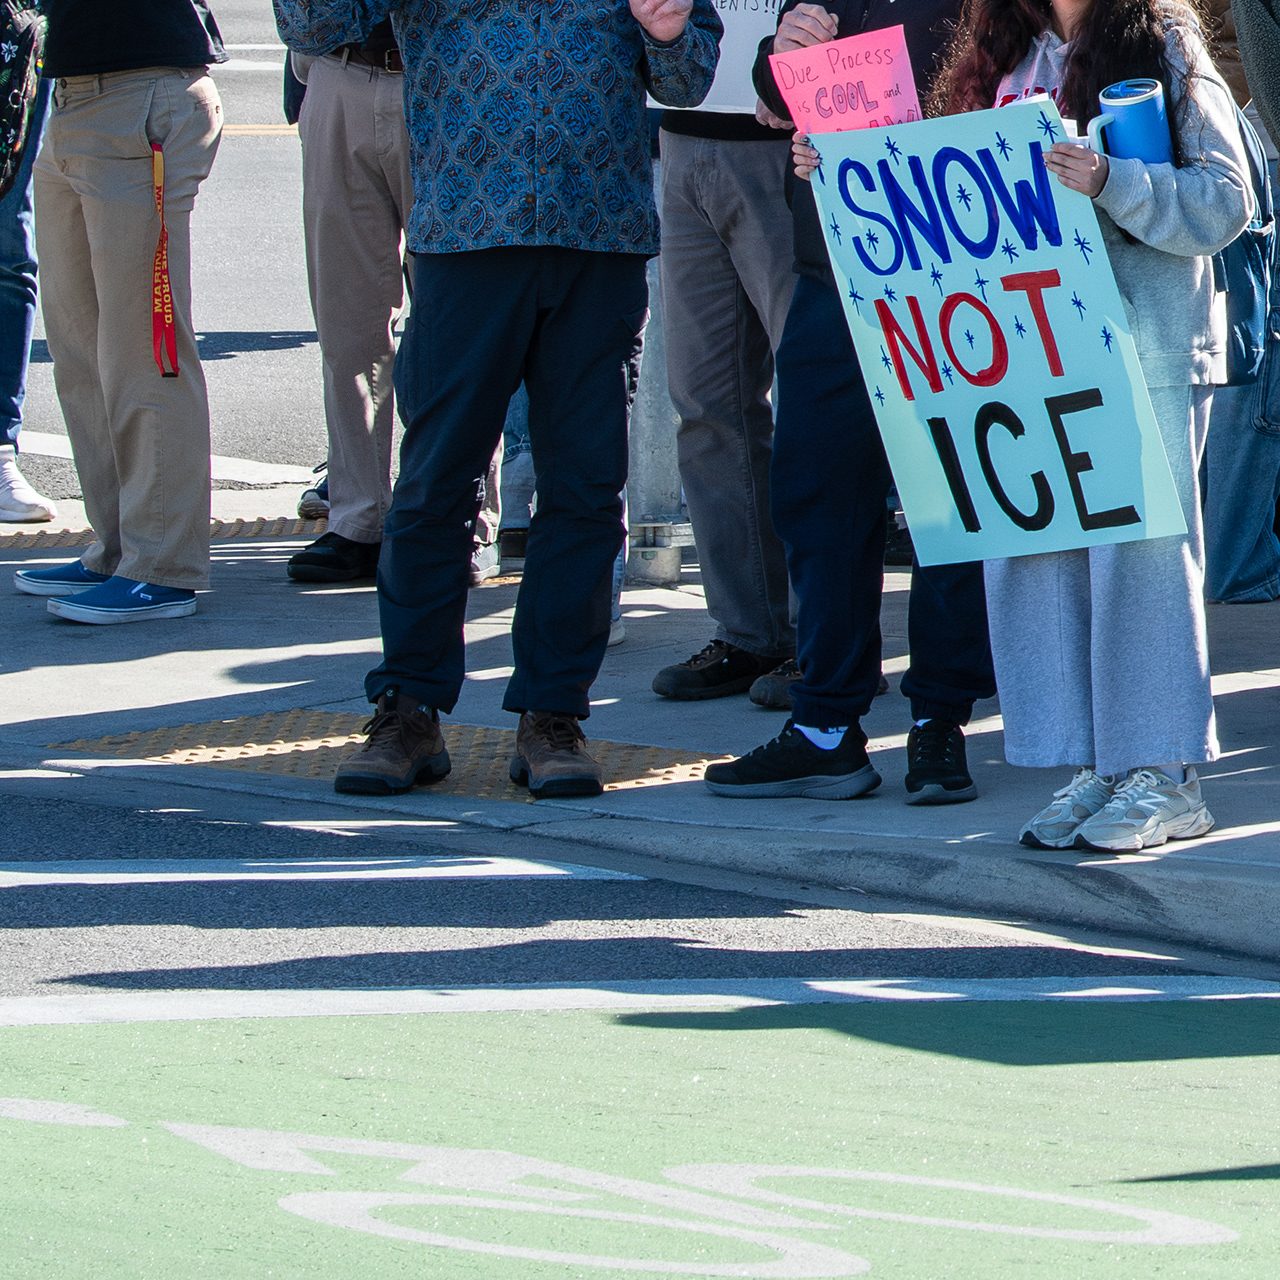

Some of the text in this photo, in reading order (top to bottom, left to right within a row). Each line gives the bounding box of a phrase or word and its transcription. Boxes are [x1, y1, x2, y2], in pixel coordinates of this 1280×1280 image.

[776, 47, 894, 90] Due Process
[795, 99, 811, 114] is
[815, 80, 879, 119] COOL
[883, 83, 902, 100] and
[837, 141, 1063, 277] SNOW
[873, 267, 1065, 402] NOT
[925, 386, 1142, 534] ICE
